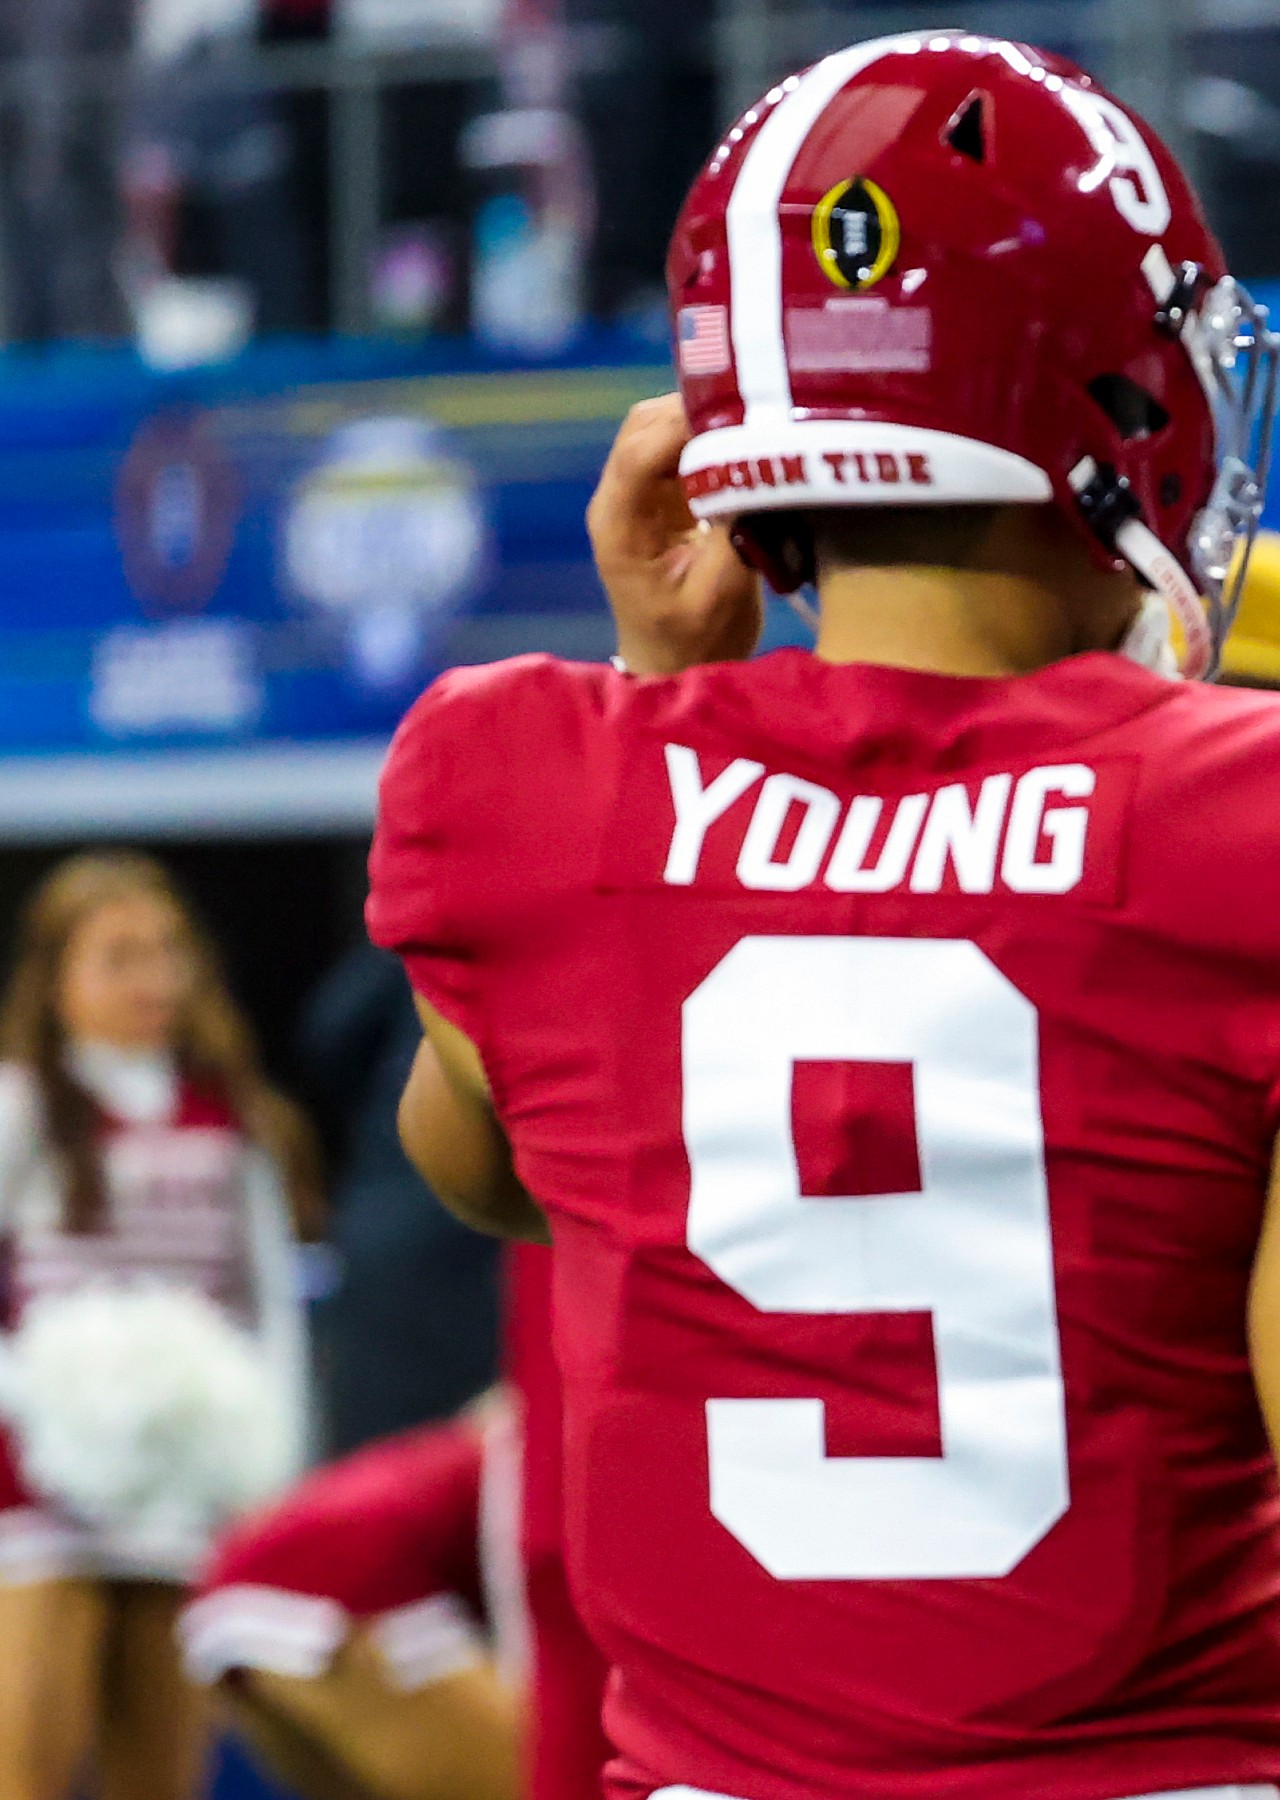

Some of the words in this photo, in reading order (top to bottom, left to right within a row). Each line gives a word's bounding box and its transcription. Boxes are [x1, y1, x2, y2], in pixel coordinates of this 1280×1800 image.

[823, 451, 932, 485] TIDE
[663, 742, 1096, 895] YOUNG
[681, 934, 1071, 1580] 9
